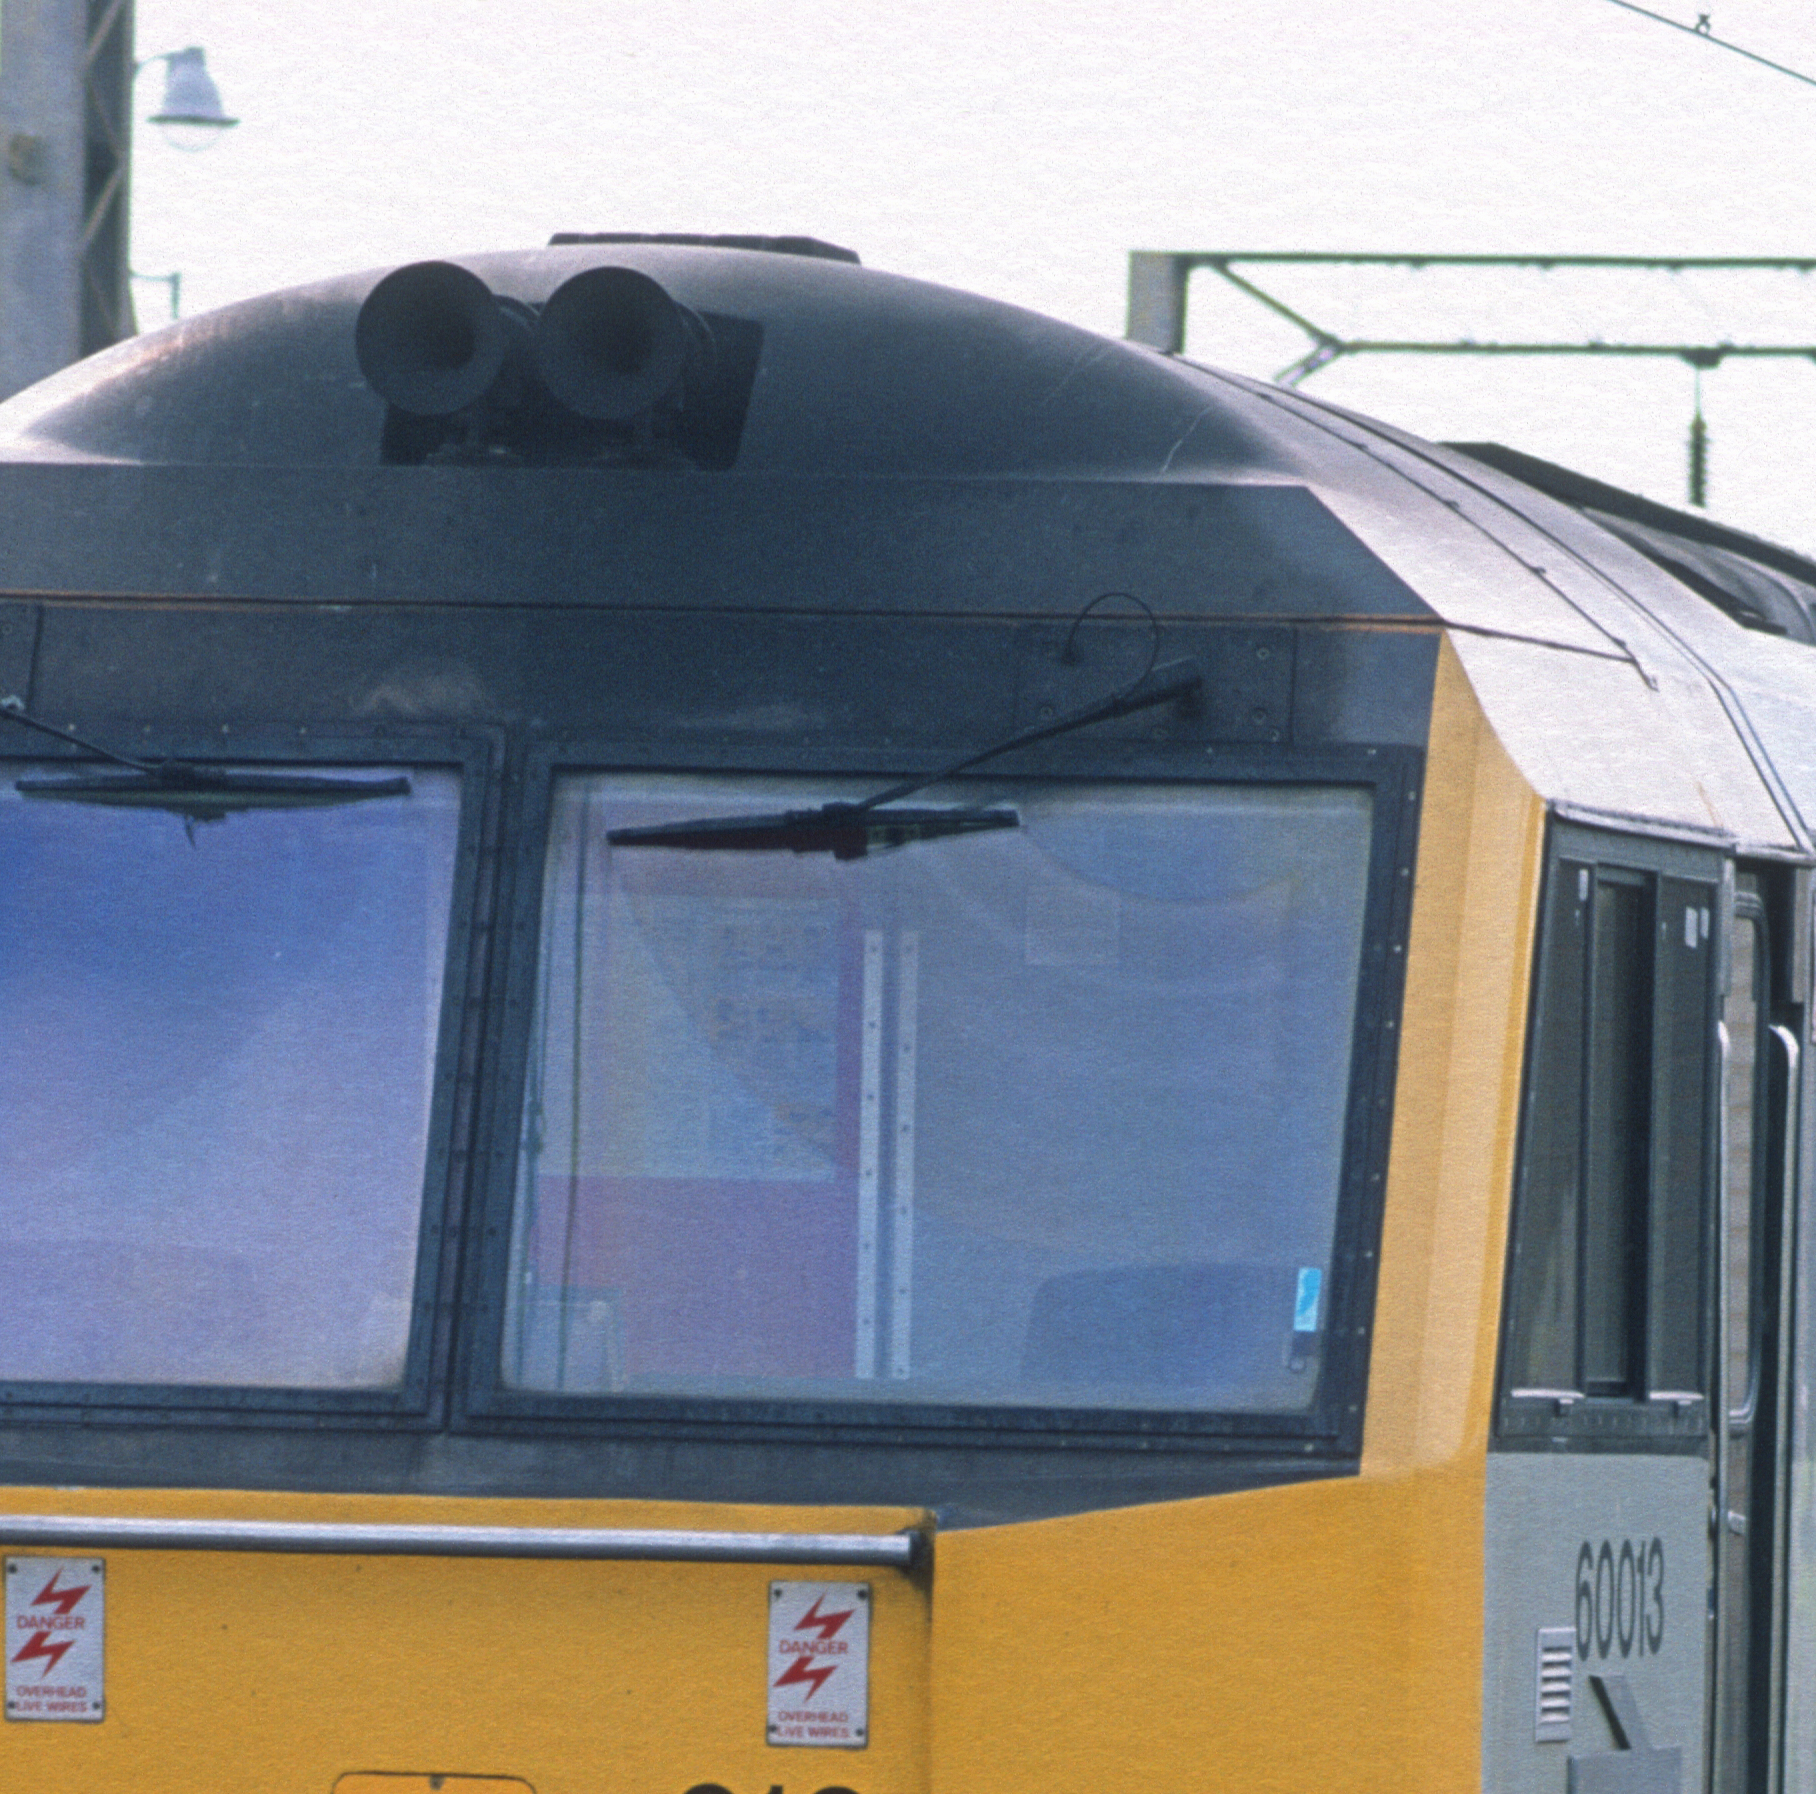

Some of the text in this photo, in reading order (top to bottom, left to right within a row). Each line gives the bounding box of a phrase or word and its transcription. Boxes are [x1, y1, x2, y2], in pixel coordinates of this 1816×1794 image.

[1575, 1536, 1664, 1662] 60013
[16, 1615, 85, 1630] DANGER
[779, 1640, 848, 1655] DANGER
[16, 1685, 87, 1698] OVERHEAD
[16, 1701, 88, 1713] LIVE WIRES
[778, 1711, 849, 1723] OVERHEAD
[777, 1726, 850, 1739] LIVE WIRES
